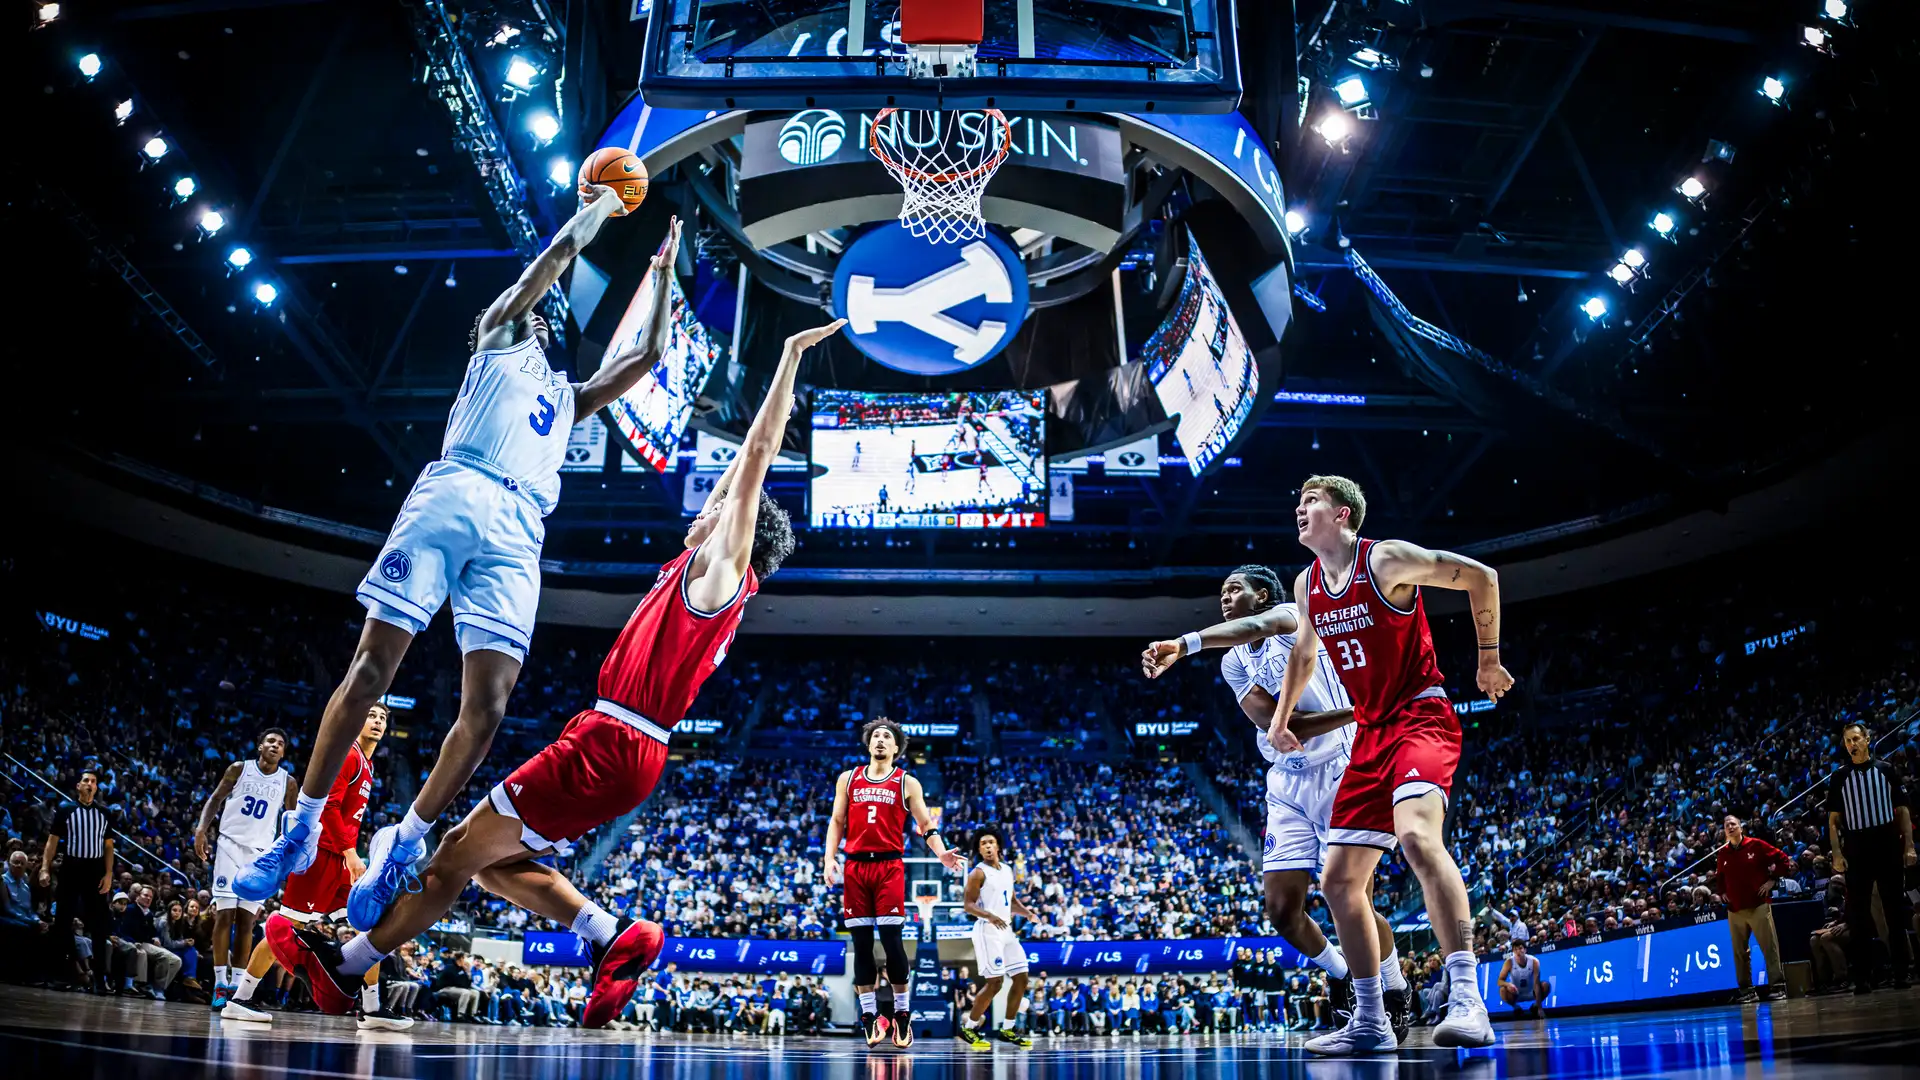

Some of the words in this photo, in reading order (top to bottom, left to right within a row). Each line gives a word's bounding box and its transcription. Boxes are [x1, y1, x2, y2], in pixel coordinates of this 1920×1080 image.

[860, 110, 940, 150] NU
[529, 394, 555, 436] 3
[45, 612, 79, 634] BYU
[1314, 602, 1369, 626] EASTERN
[1316, 615, 1375, 638] WASHINGTON
[1337, 638, 1367, 671] 33
[1136, 722, 1169, 736] BYU
[243, 782, 279, 801] BYU
[853, 787, 897, 798] EASTERN
[853, 795, 896, 805] WASHINGTON
[241, 795, 269, 820] 30
[867, 805, 877, 824] 2
[1002, 890, 1009, 907] 1
